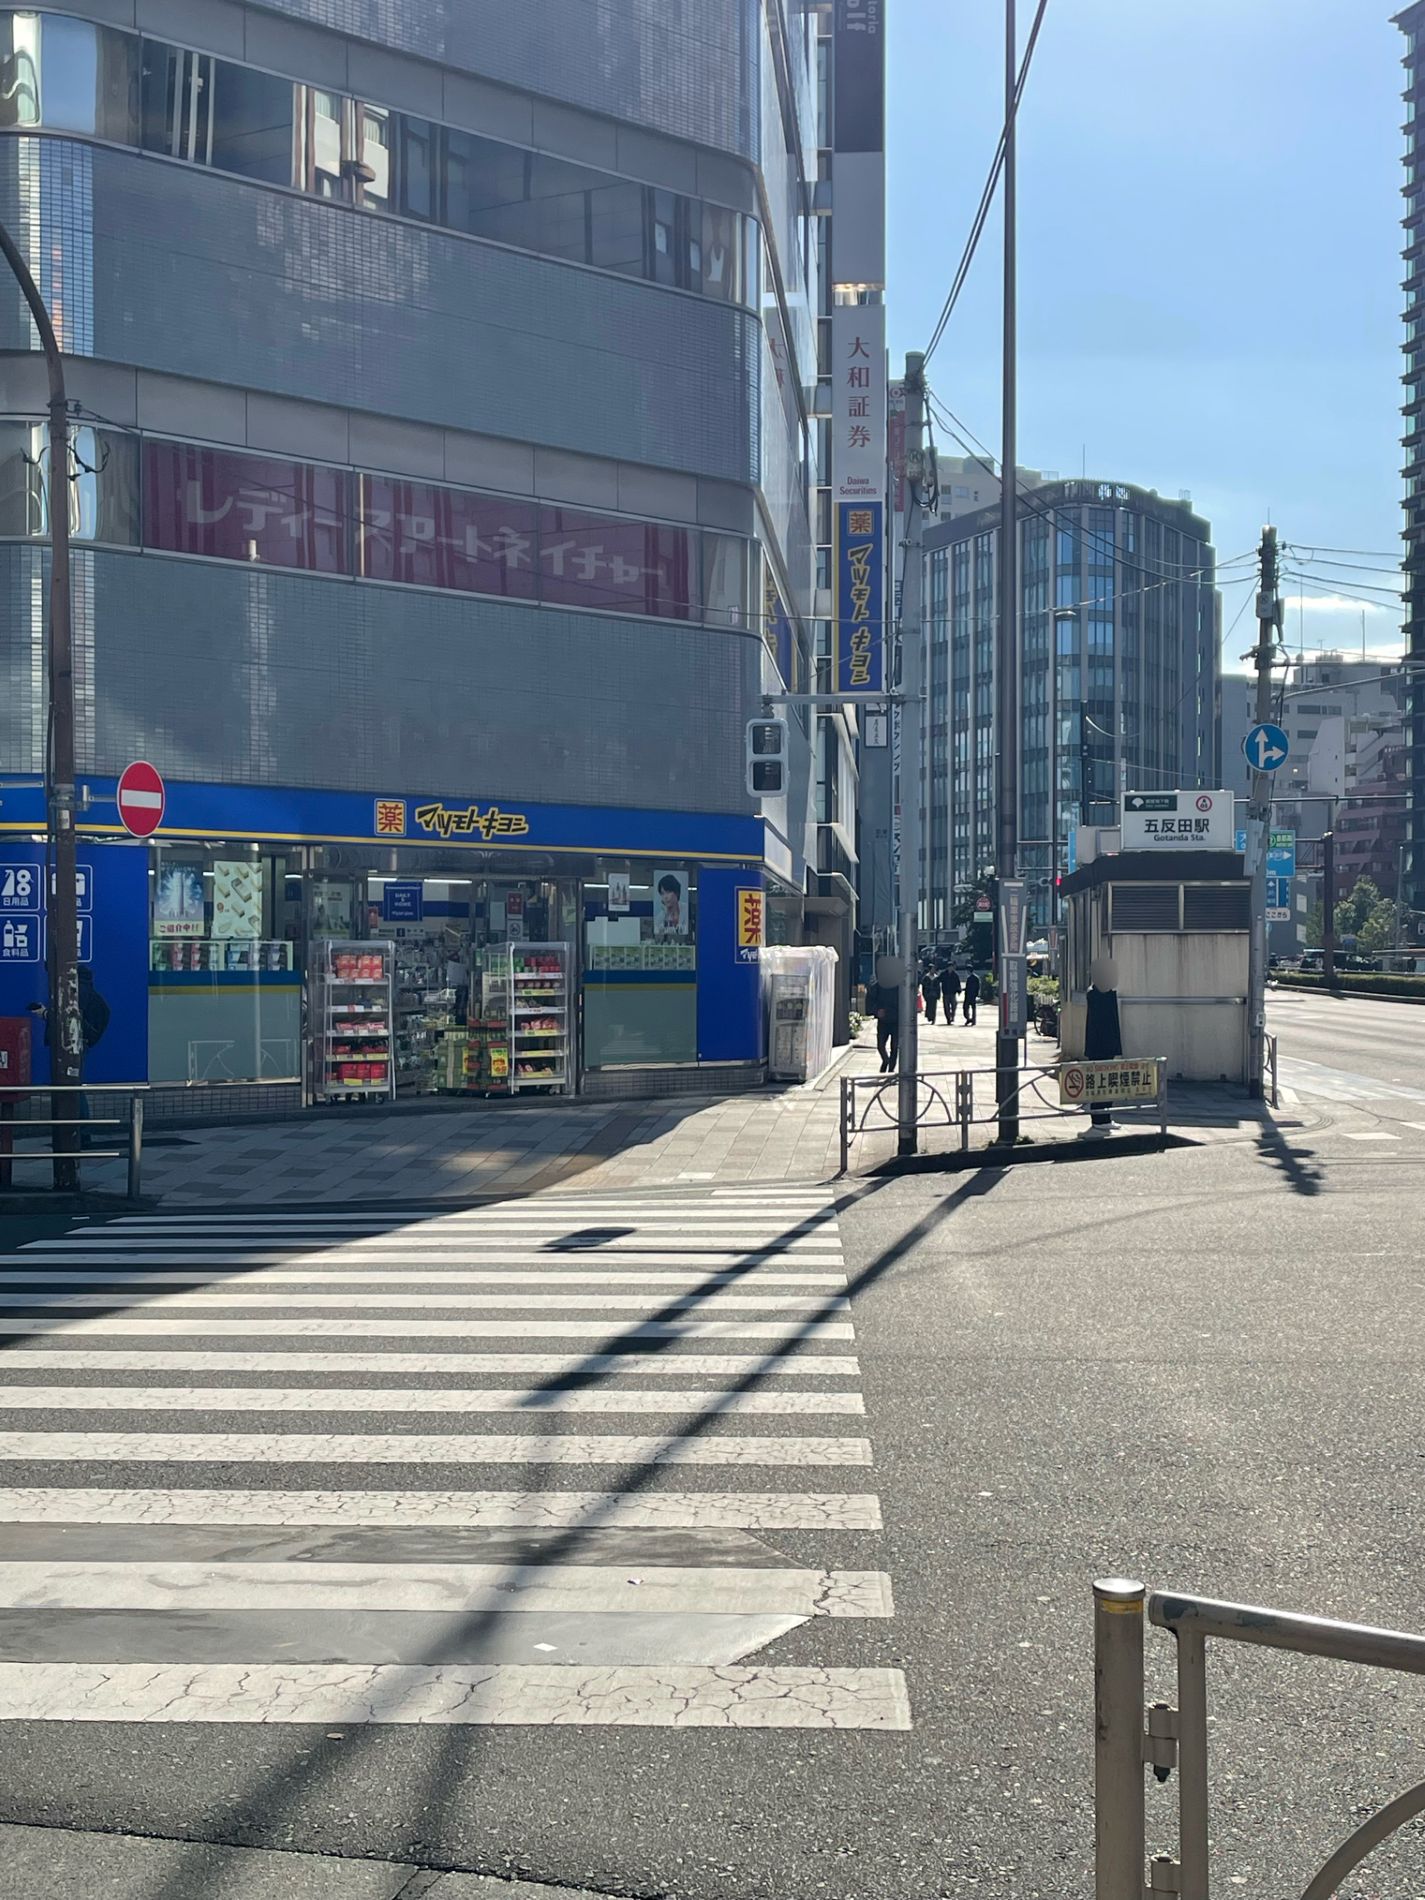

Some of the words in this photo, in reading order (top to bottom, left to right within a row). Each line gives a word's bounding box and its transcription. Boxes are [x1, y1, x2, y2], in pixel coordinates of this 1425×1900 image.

[847, 336, 871, 448] 大和証券
[847, 477, 869, 485] Daiwa
[840, 486, 877, 495] Securities
[182, 480, 664, 583] レディースアートネイチャー
[850, 512, 871, 533] 薬
[847, 543, 873, 686] マツモトキヨシ
[378, 803, 402, 833] 薬
[416, 804, 528, 839] マツモトキヨシ
[1144, 818, 1210, 833] 五反田駅
[1153, 834, 1189, 842] Gotanda
[3, 897, 29, 906] 日用品
[744, 894, 762, 944] 薬
[2, 948, 29, 957] 食料品
[1085, 1071, 1152, 1089] 路上喫煙禁止
